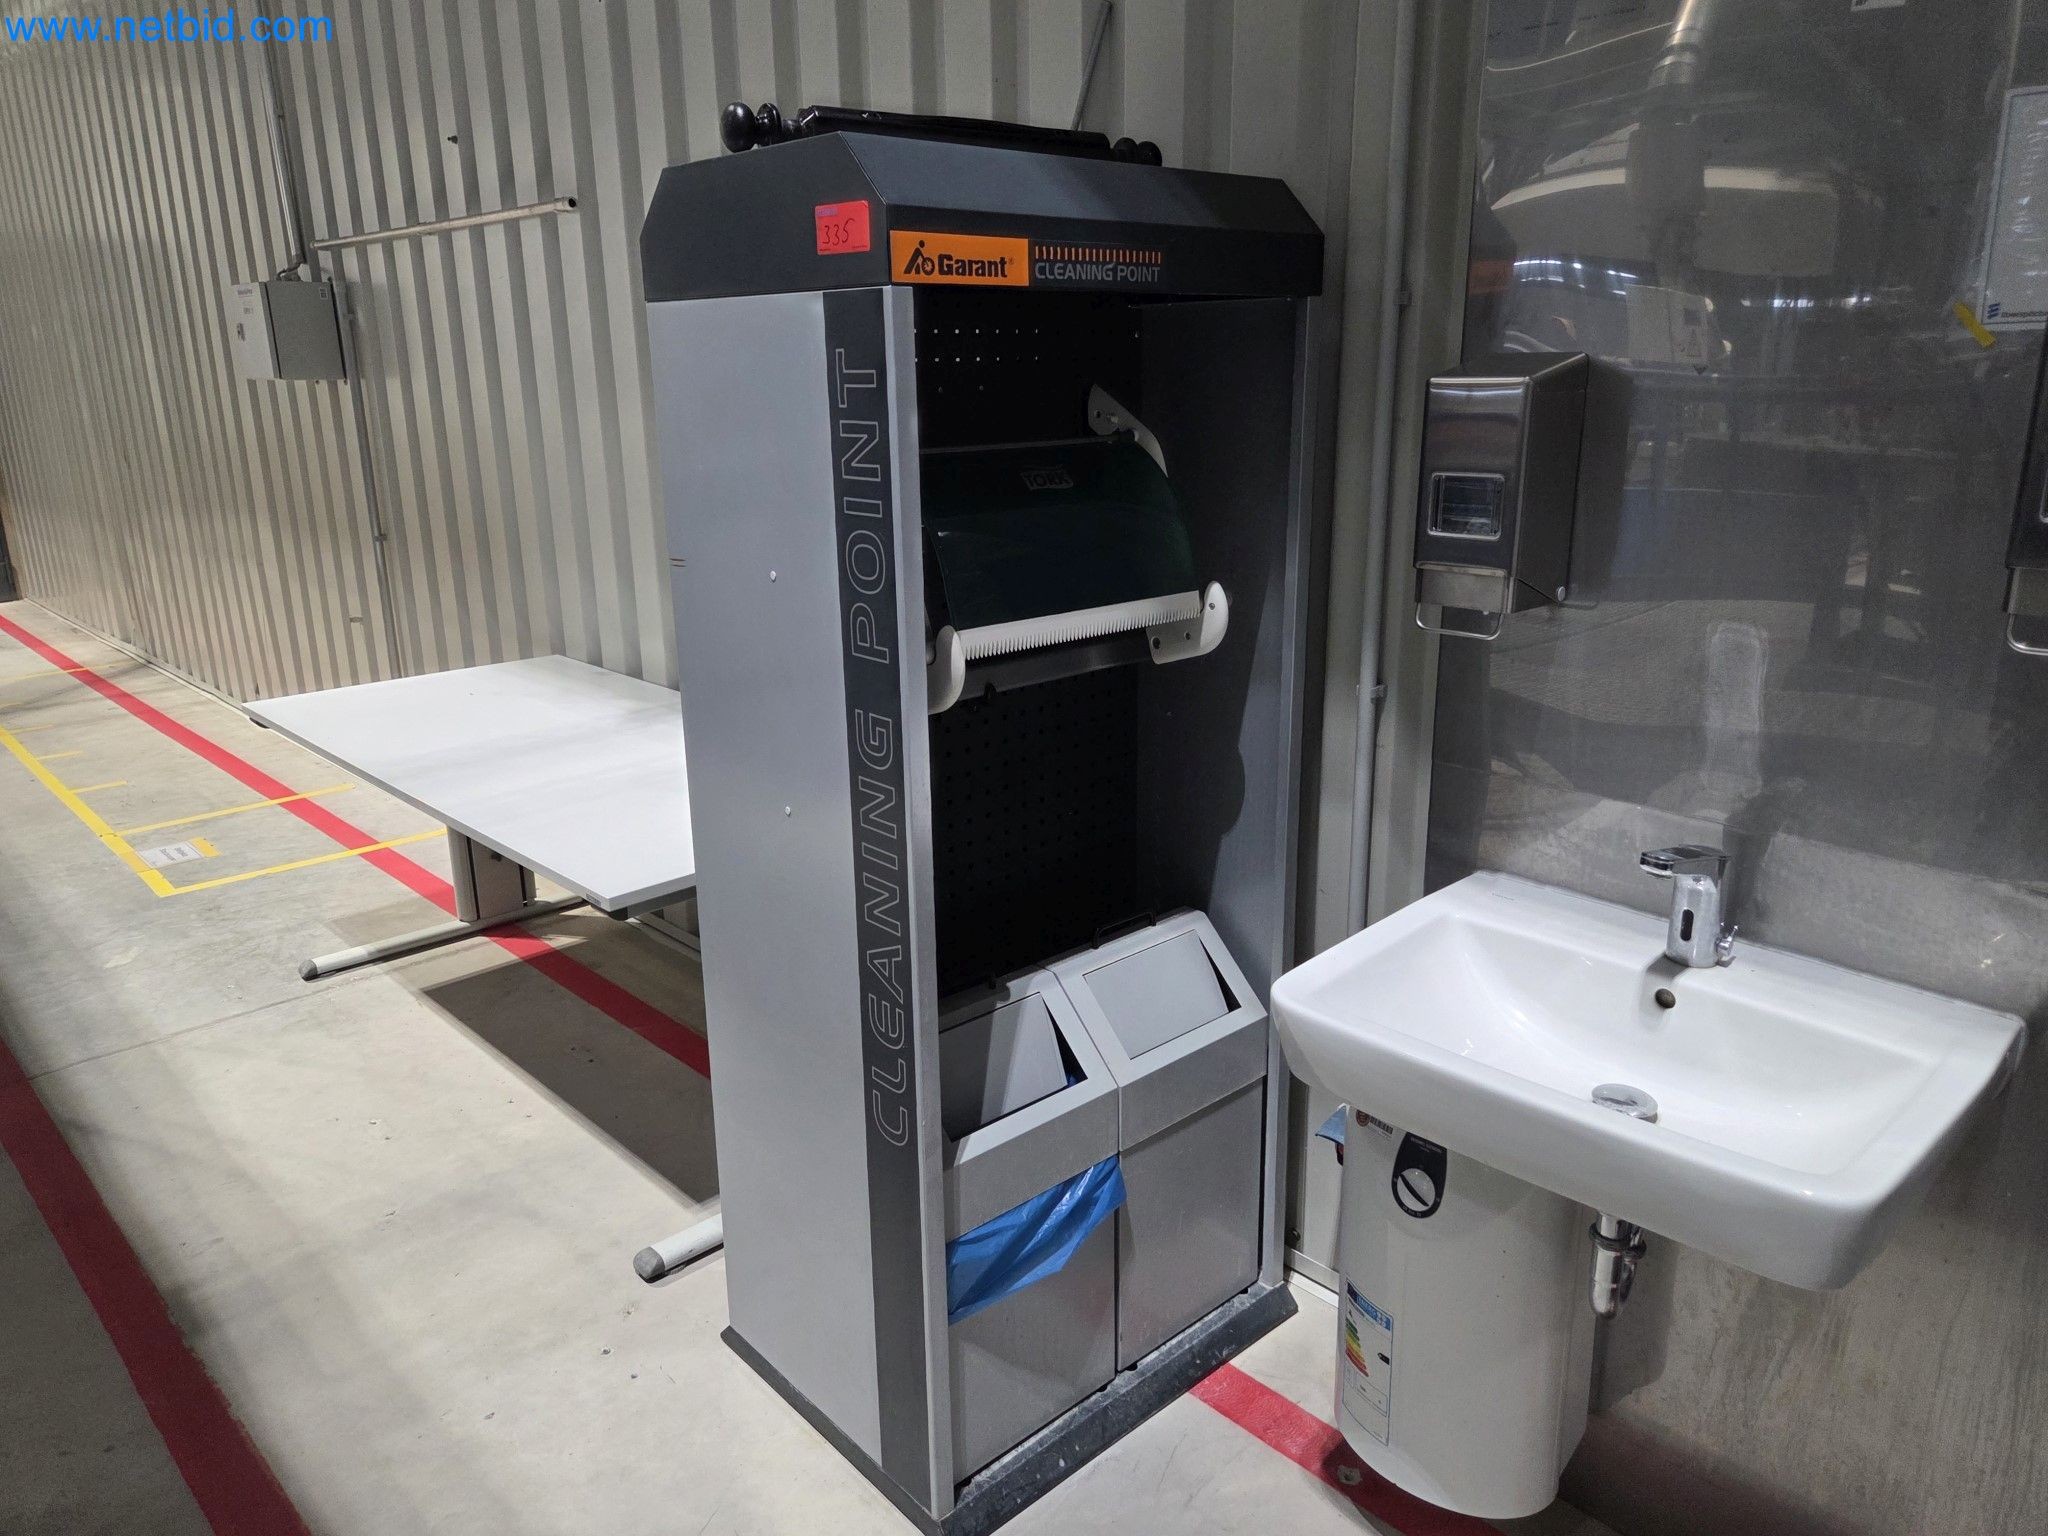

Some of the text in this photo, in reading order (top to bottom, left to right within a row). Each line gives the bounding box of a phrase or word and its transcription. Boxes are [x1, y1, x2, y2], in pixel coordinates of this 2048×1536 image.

[822, 217, 855, 246] 335
[1034, 262, 1160, 282] CLEANING POINT
[835, 348, 909, 1146] CLEANING POINT
